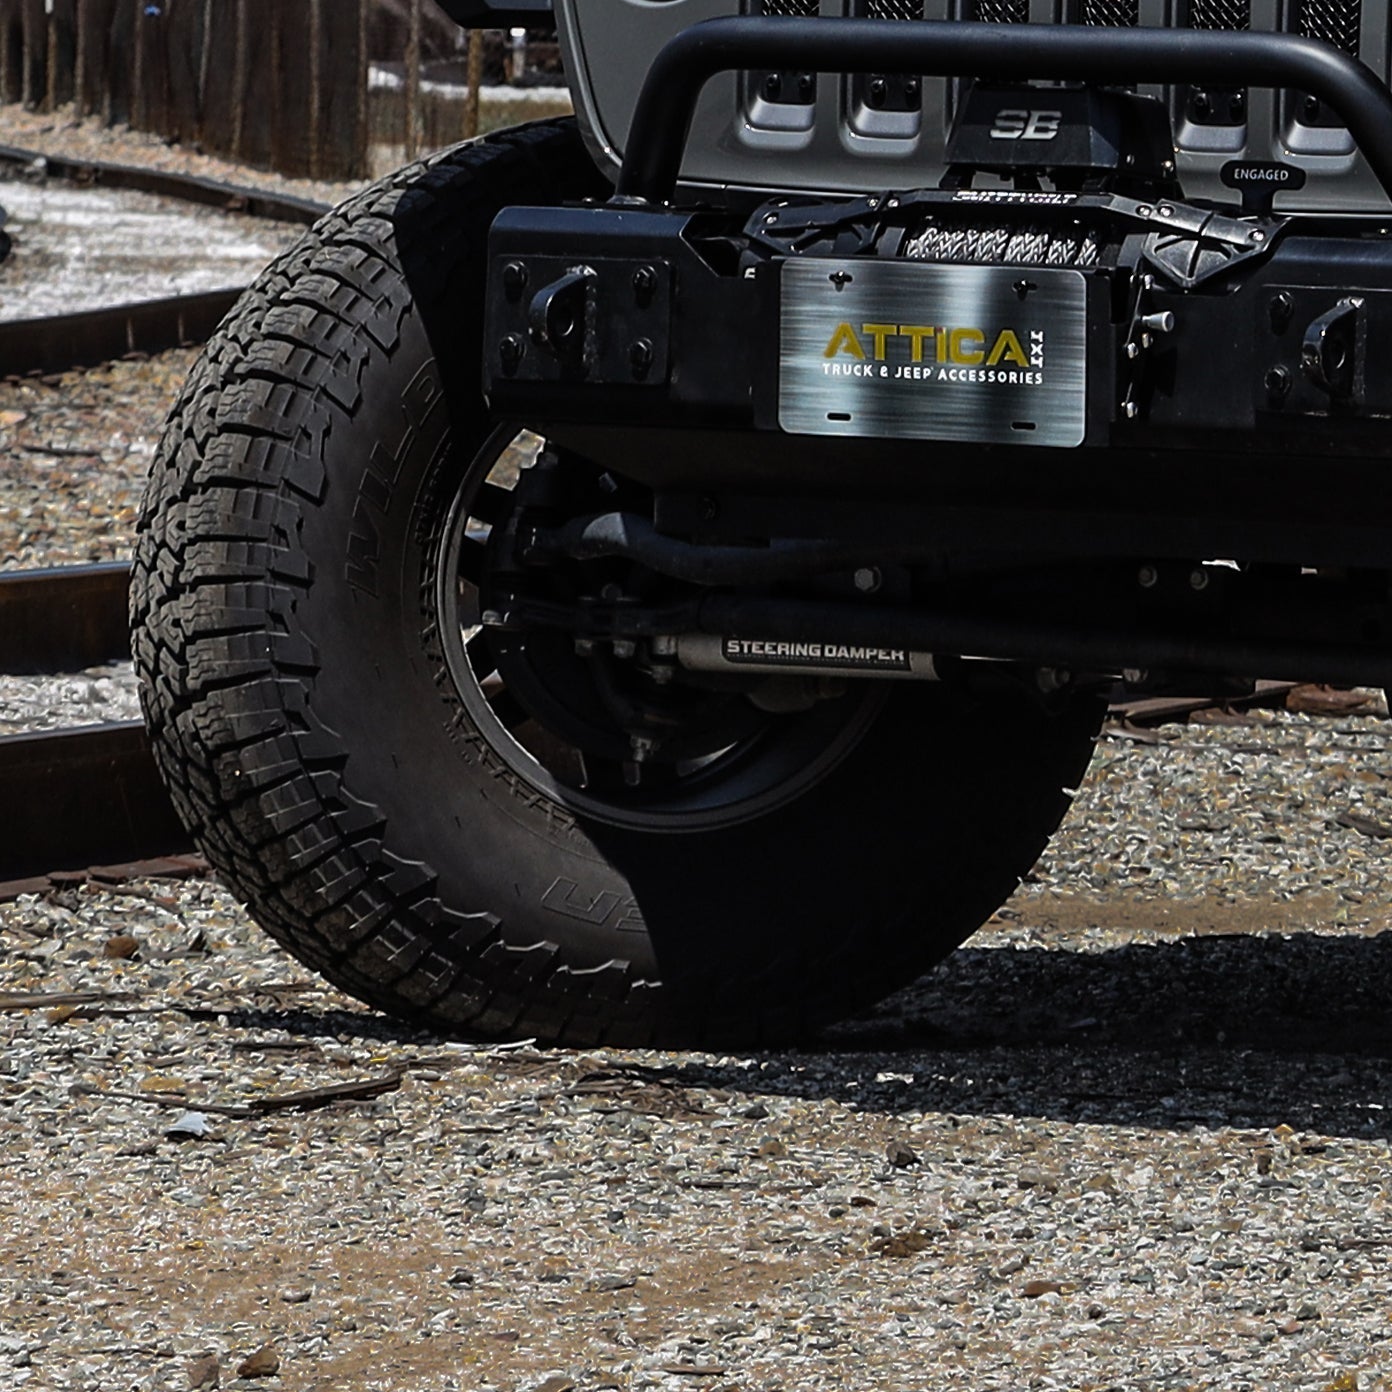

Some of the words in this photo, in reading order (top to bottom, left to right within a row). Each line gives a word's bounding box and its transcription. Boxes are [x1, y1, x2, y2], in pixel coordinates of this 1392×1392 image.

[1233, 167, 1290, 183] ENGAGED
[822, 362, 874, 377] TRUCK
[879, 365, 889, 378] &
[894, 365, 932, 380] JEEP
[937, 367, 1043, 386] ACCESSORIES
[726, 639, 822, 658] STEERING
[823, 643, 905, 662] DAMPER
